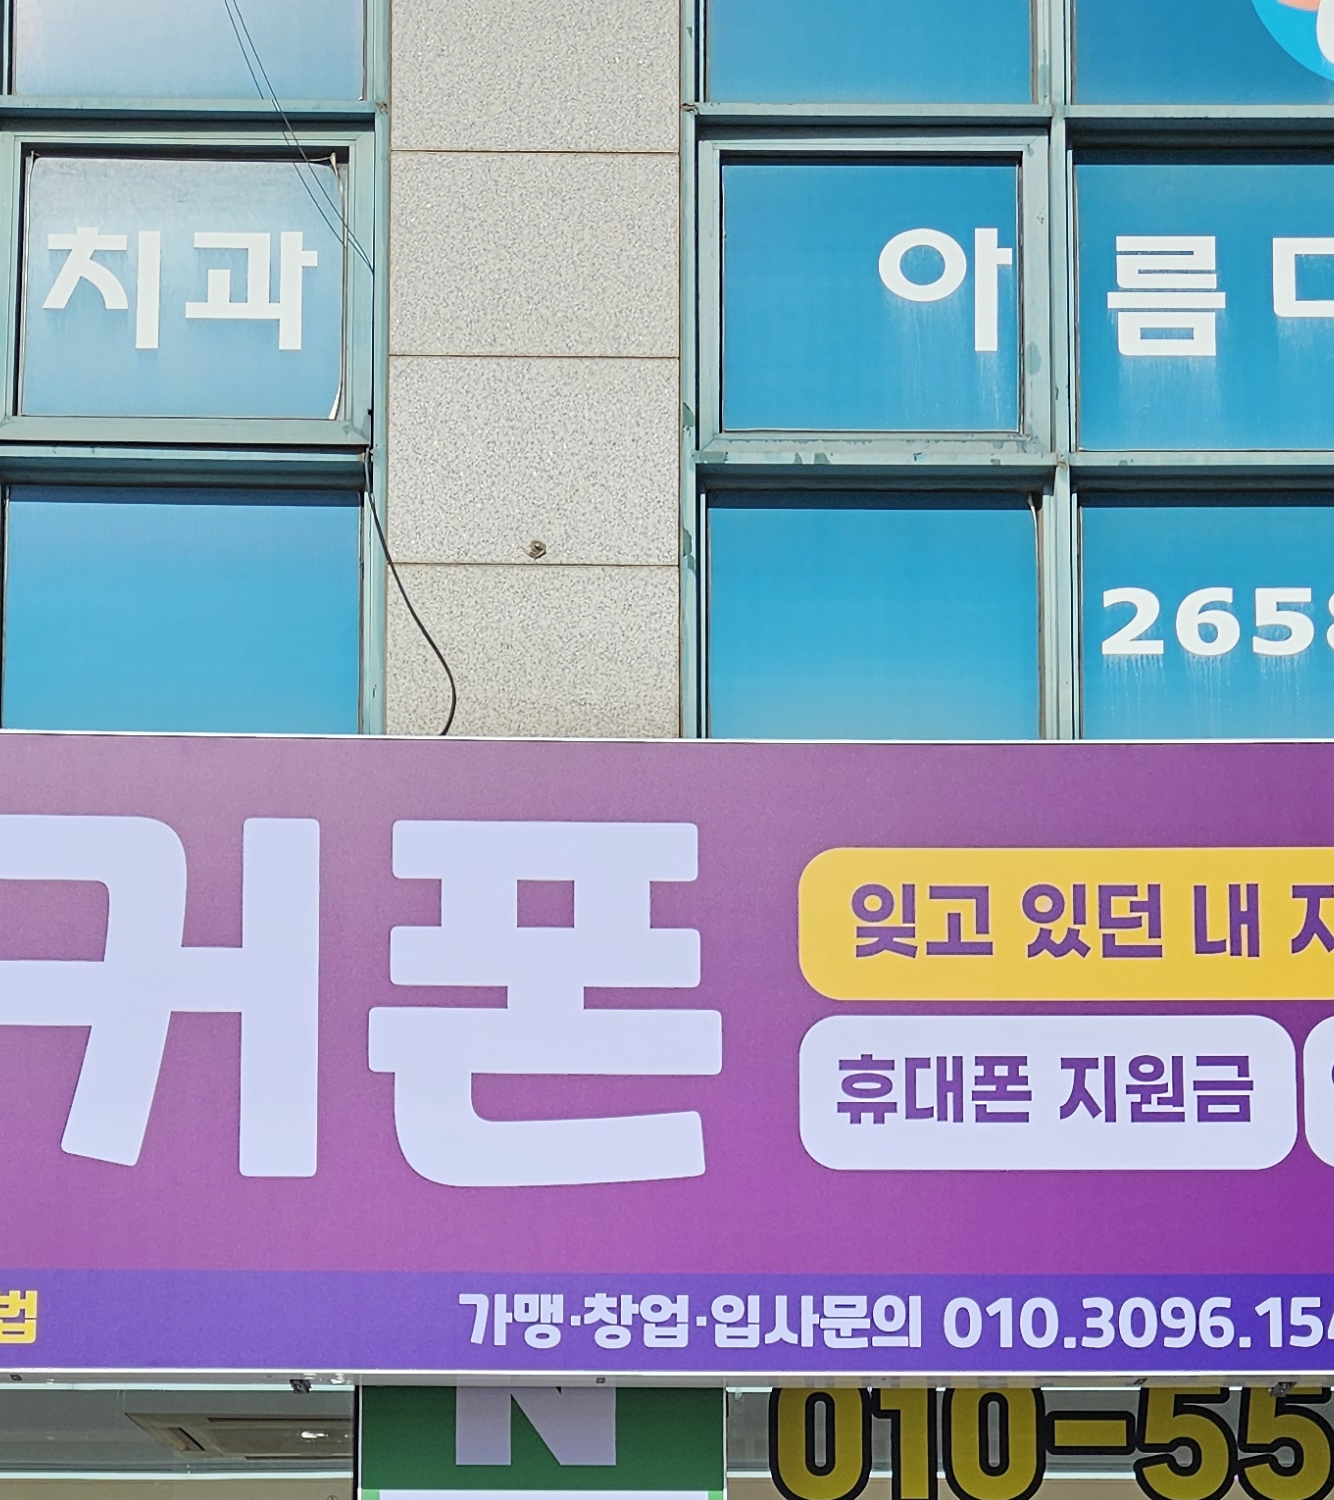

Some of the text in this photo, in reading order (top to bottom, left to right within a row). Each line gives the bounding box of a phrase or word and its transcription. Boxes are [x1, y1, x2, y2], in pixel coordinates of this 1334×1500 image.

[851, 883, 995, 960] 잊고
[1021, 883, 1163, 959] 있던
[1194, 883, 1260, 958] 내
[836, 1053, 1255, 1126] 휴대폰 지원금
